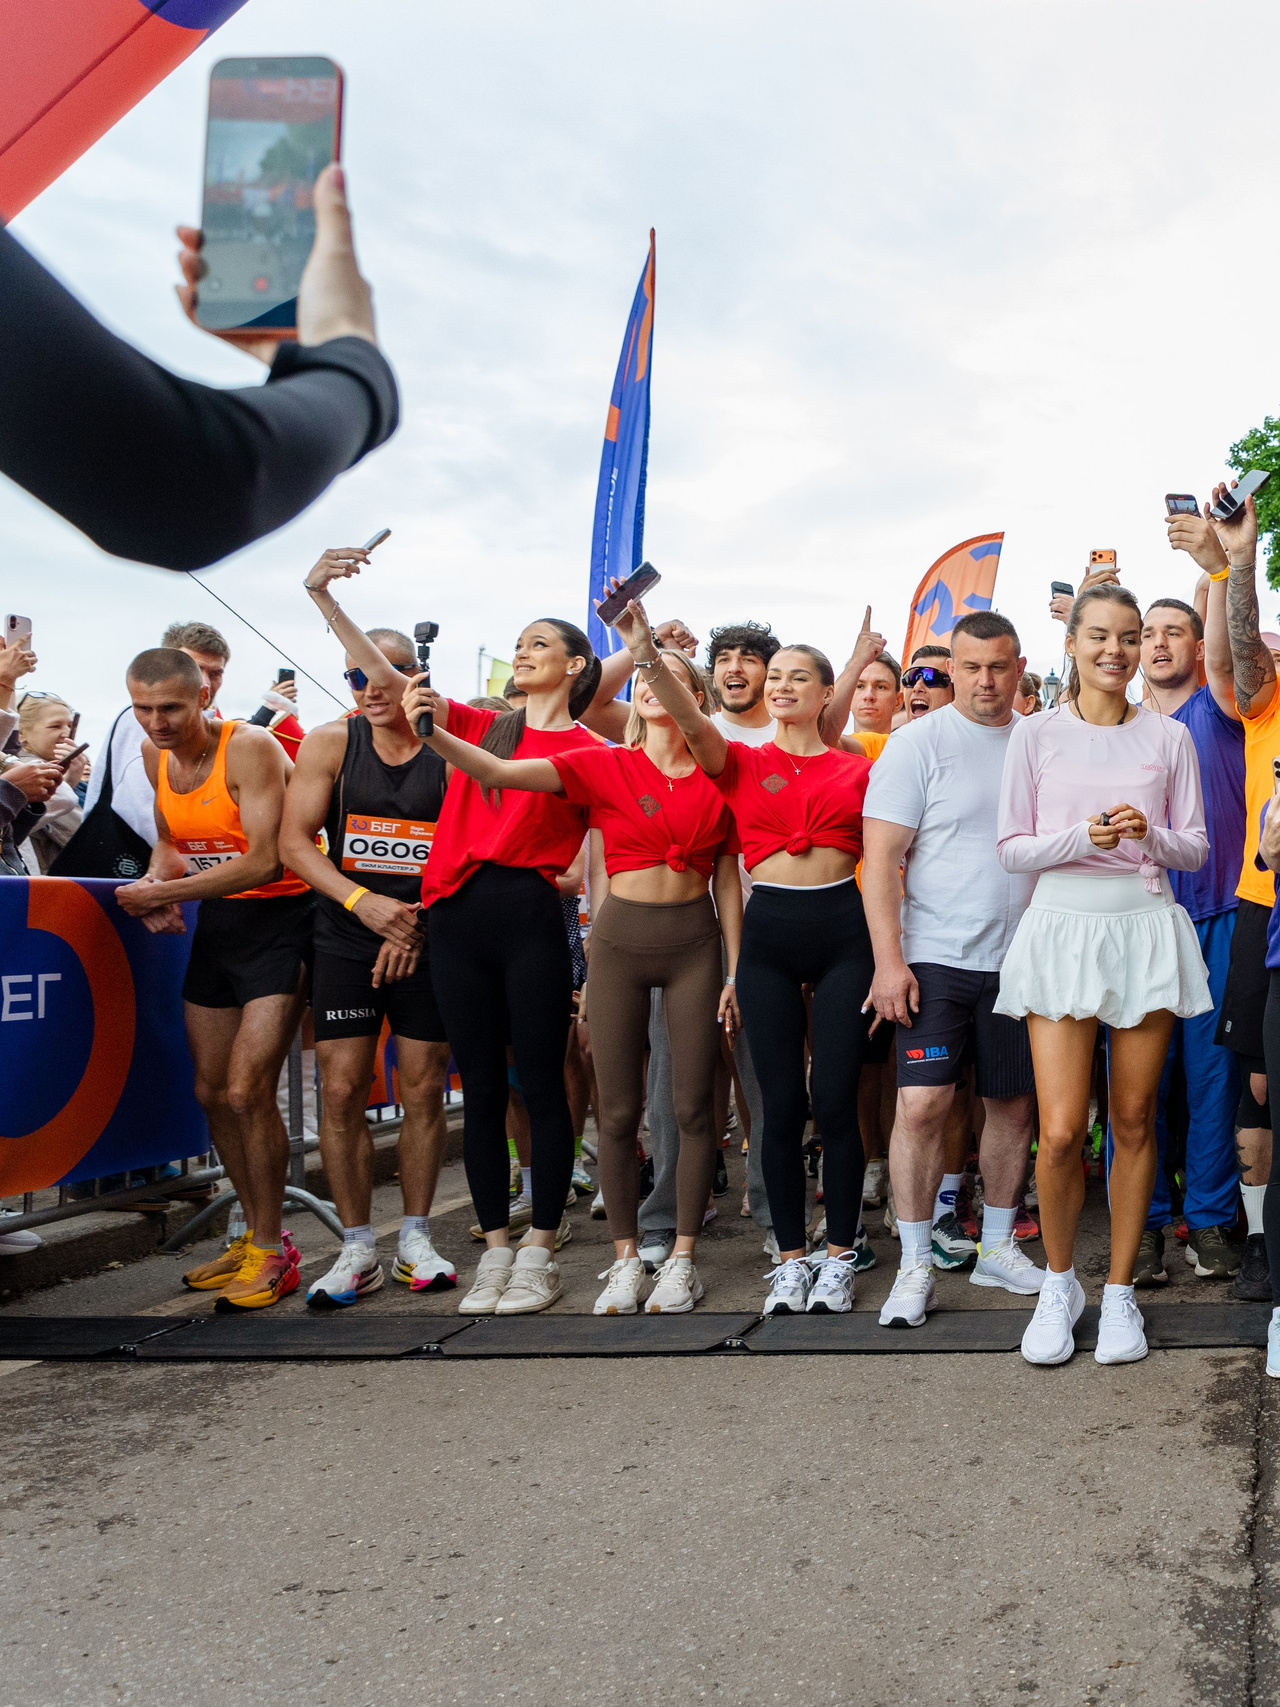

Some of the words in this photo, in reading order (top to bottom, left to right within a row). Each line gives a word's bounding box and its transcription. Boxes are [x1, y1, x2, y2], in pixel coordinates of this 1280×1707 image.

[370, 821, 401, 834] БЕГ
[187, 841, 208, 851] БЕГ
[349, 838, 431, 861] 0606
[377, 863, 409, 871] КЛАСТЕР
[325, 1008, 376, 1021] RUSSIA
[925, 1045, 949, 1058] IBA
